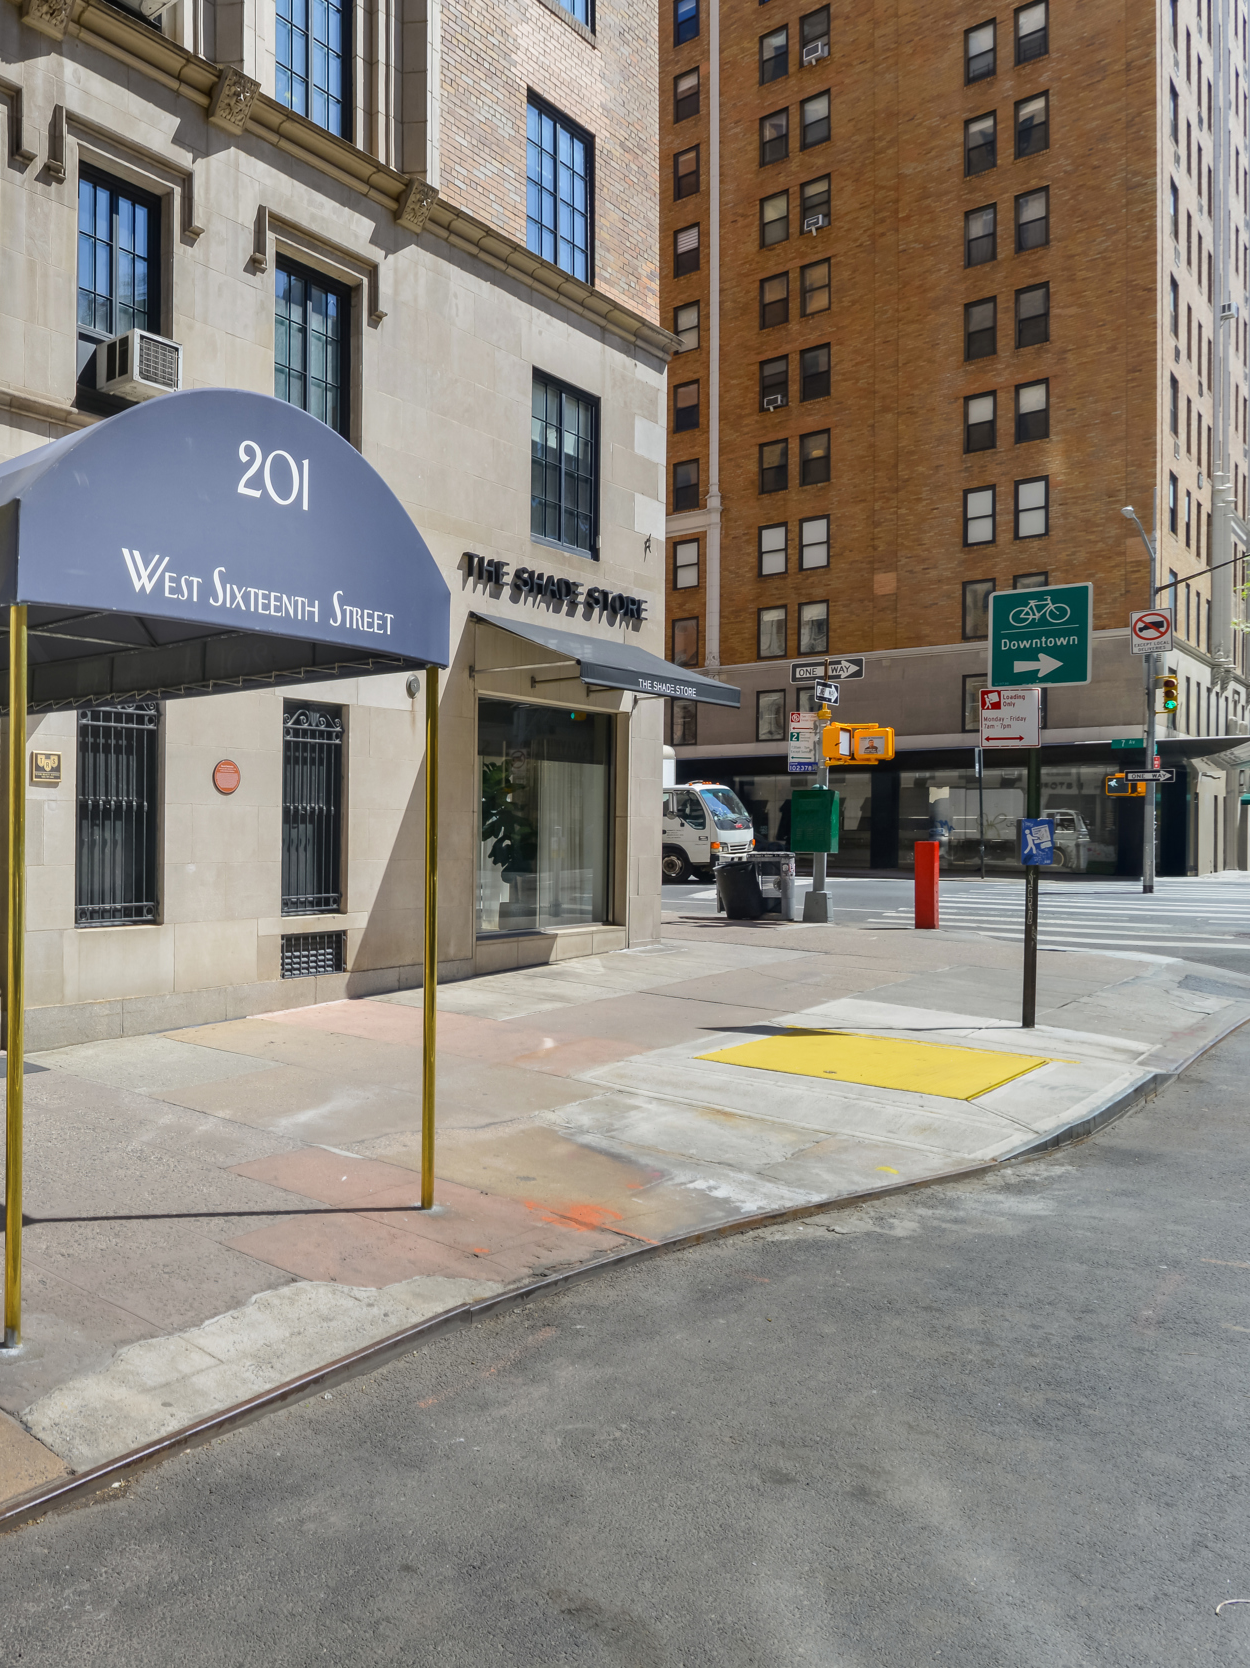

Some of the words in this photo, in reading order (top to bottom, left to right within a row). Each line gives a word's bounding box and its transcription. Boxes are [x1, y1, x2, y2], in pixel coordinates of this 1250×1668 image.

[237, 440, 309, 511] 201
[463, 552, 510, 586] THE
[514, 567, 584, 605] SHADE
[587, 586, 648, 621] STORE
[1001, 635, 1078, 650] Downtown
[798, 667, 818, 677] ONE
[830, 665, 851, 674] WAY
[638, 678, 652, 690] THE
[653, 681, 675, 694] SHADE
[675, 685, 697, 697] STORE
[1002, 693, 1026, 701] Loading
[792, 732, 798, 741] 2
[1121, 740, 1126, 748] 7
